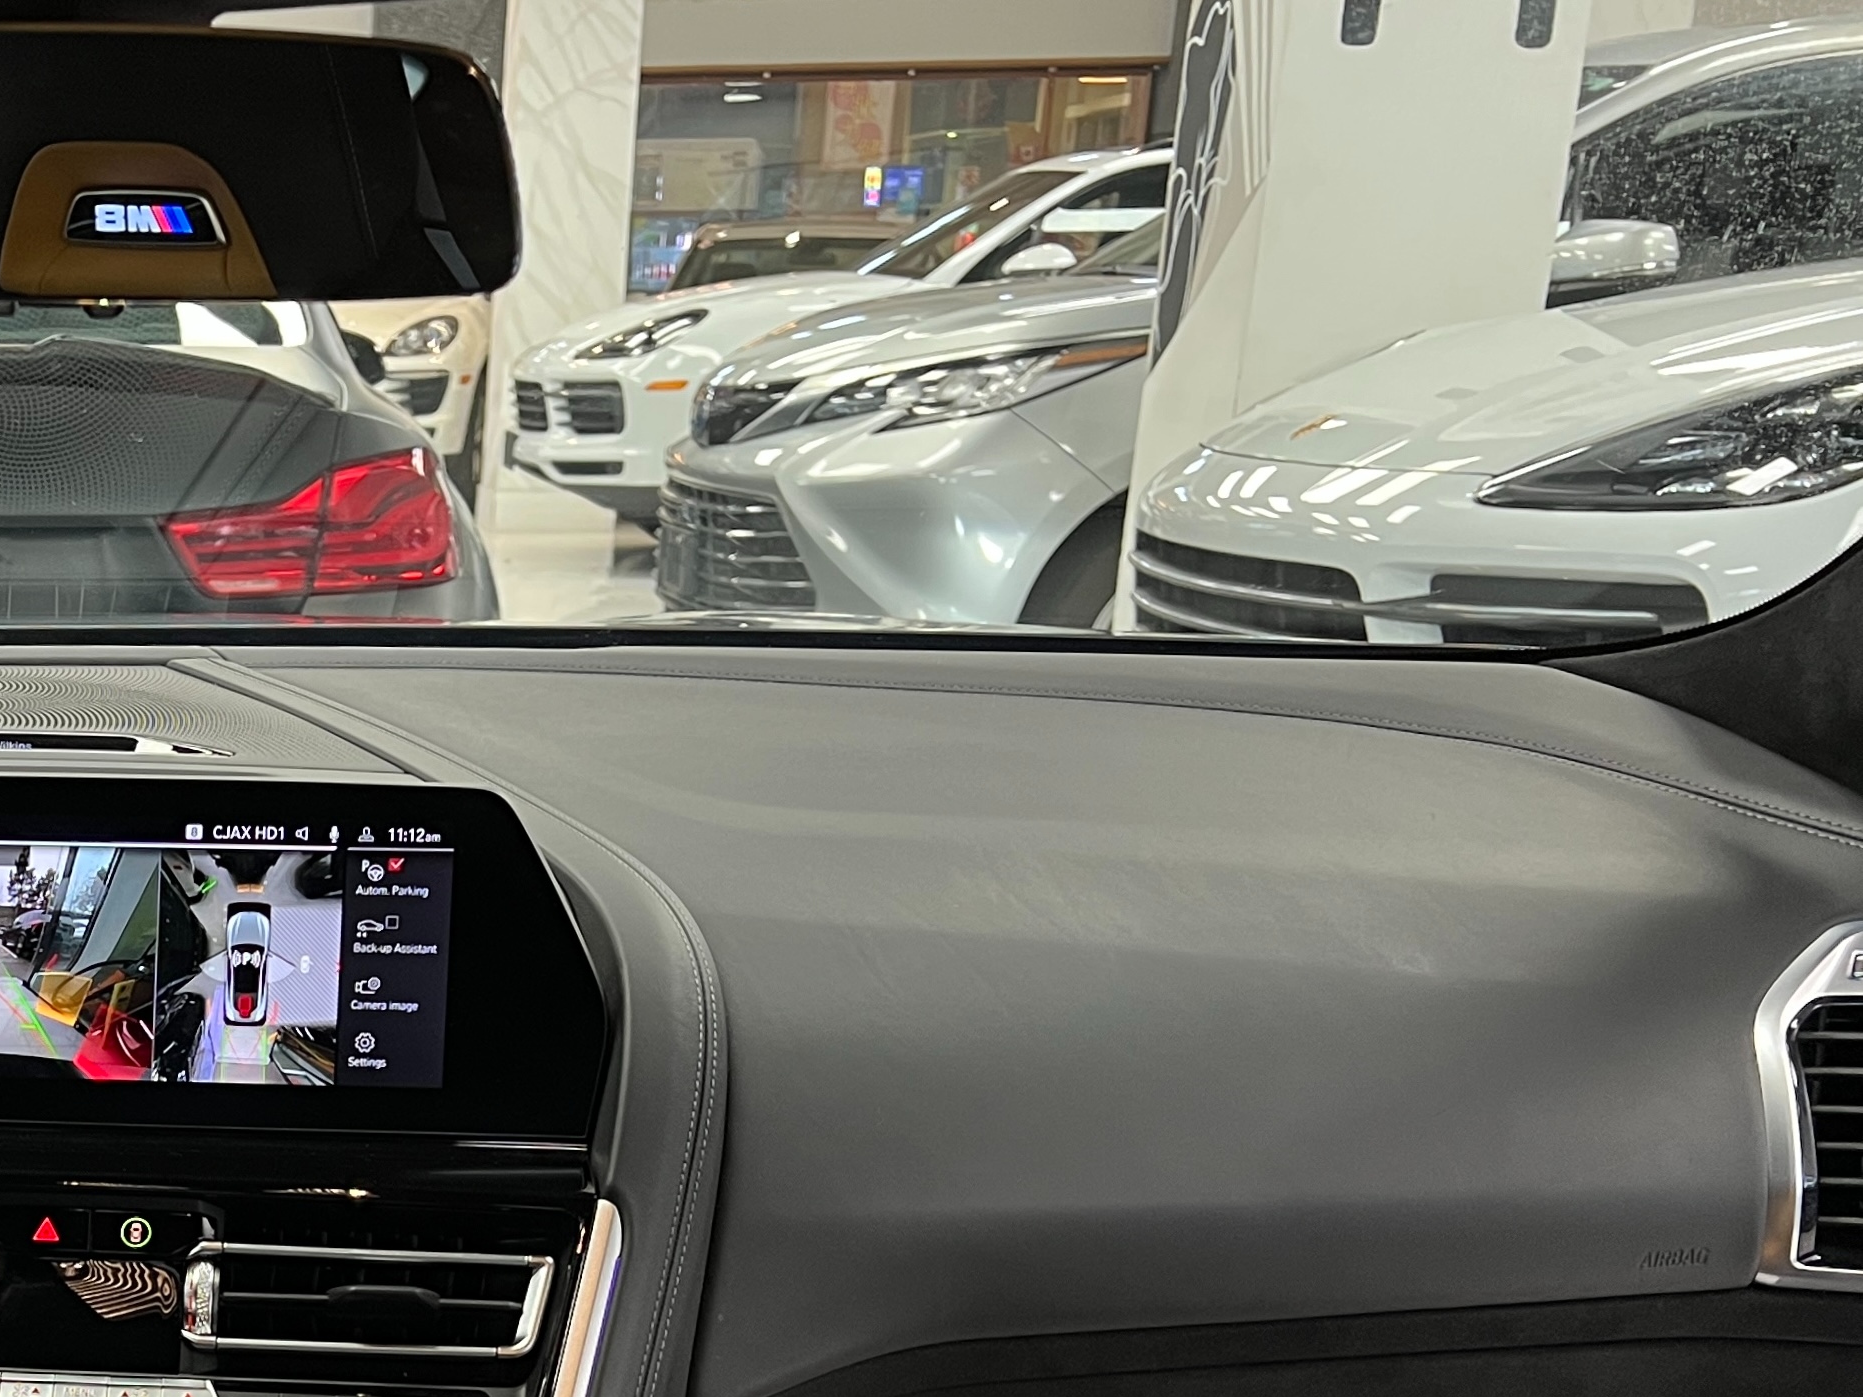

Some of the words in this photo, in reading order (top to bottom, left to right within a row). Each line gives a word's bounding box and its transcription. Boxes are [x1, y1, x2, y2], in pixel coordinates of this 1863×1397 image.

[212, 825, 251, 840] CJAX
[255, 826, 285, 840] HD1
[356, 885, 390, 896] Autom.
[392, 886, 429, 898] Parking
[353, 943, 392, 954] Back-up
[394, 944, 438, 954] Assistant
[350, 1000, 387, 1011] Camera
[389, 1001, 419, 1013] image
[348, 1057, 386, 1069] Settings
[1640, 1249, 1710, 1269] AIRBAG
